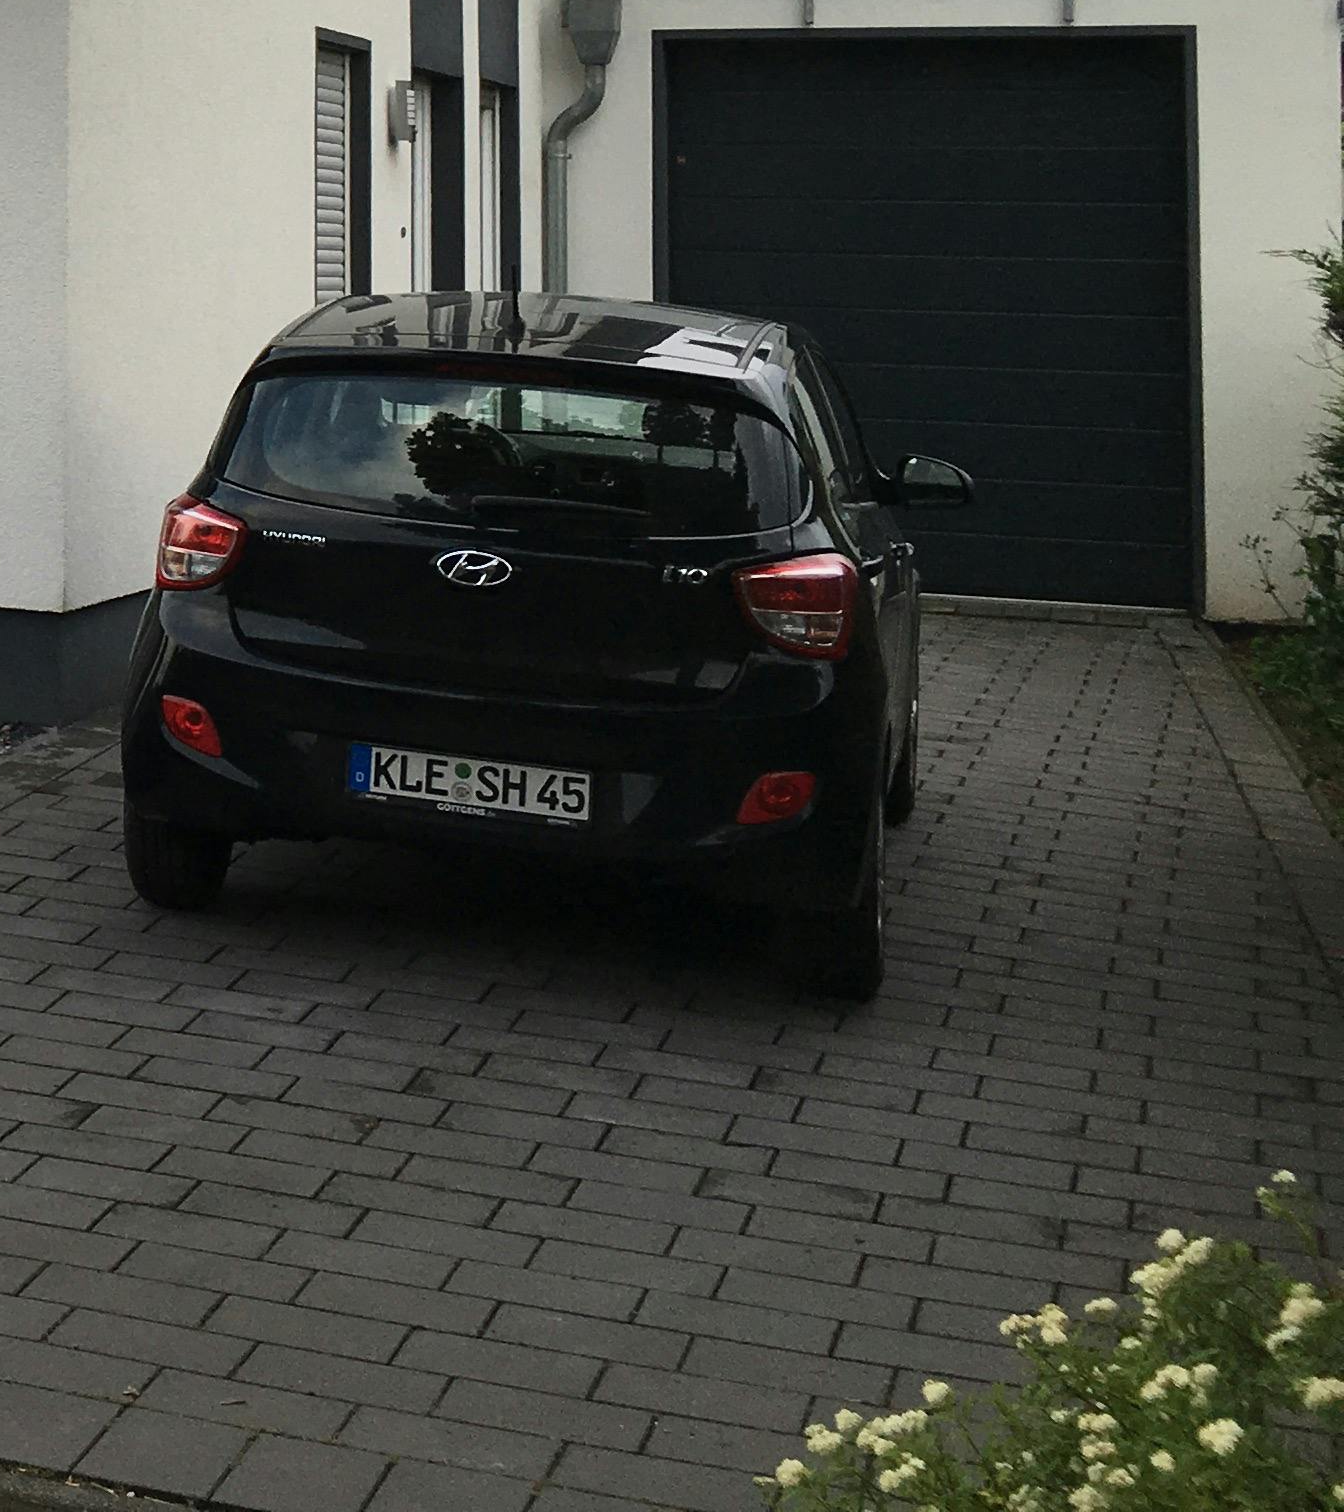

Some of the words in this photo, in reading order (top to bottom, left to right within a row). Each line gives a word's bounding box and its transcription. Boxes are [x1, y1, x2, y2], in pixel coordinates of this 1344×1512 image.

[373, 751, 449, 797] KLE
[475, 765, 527, 808] SH
[536, 774, 587, 814] 45
